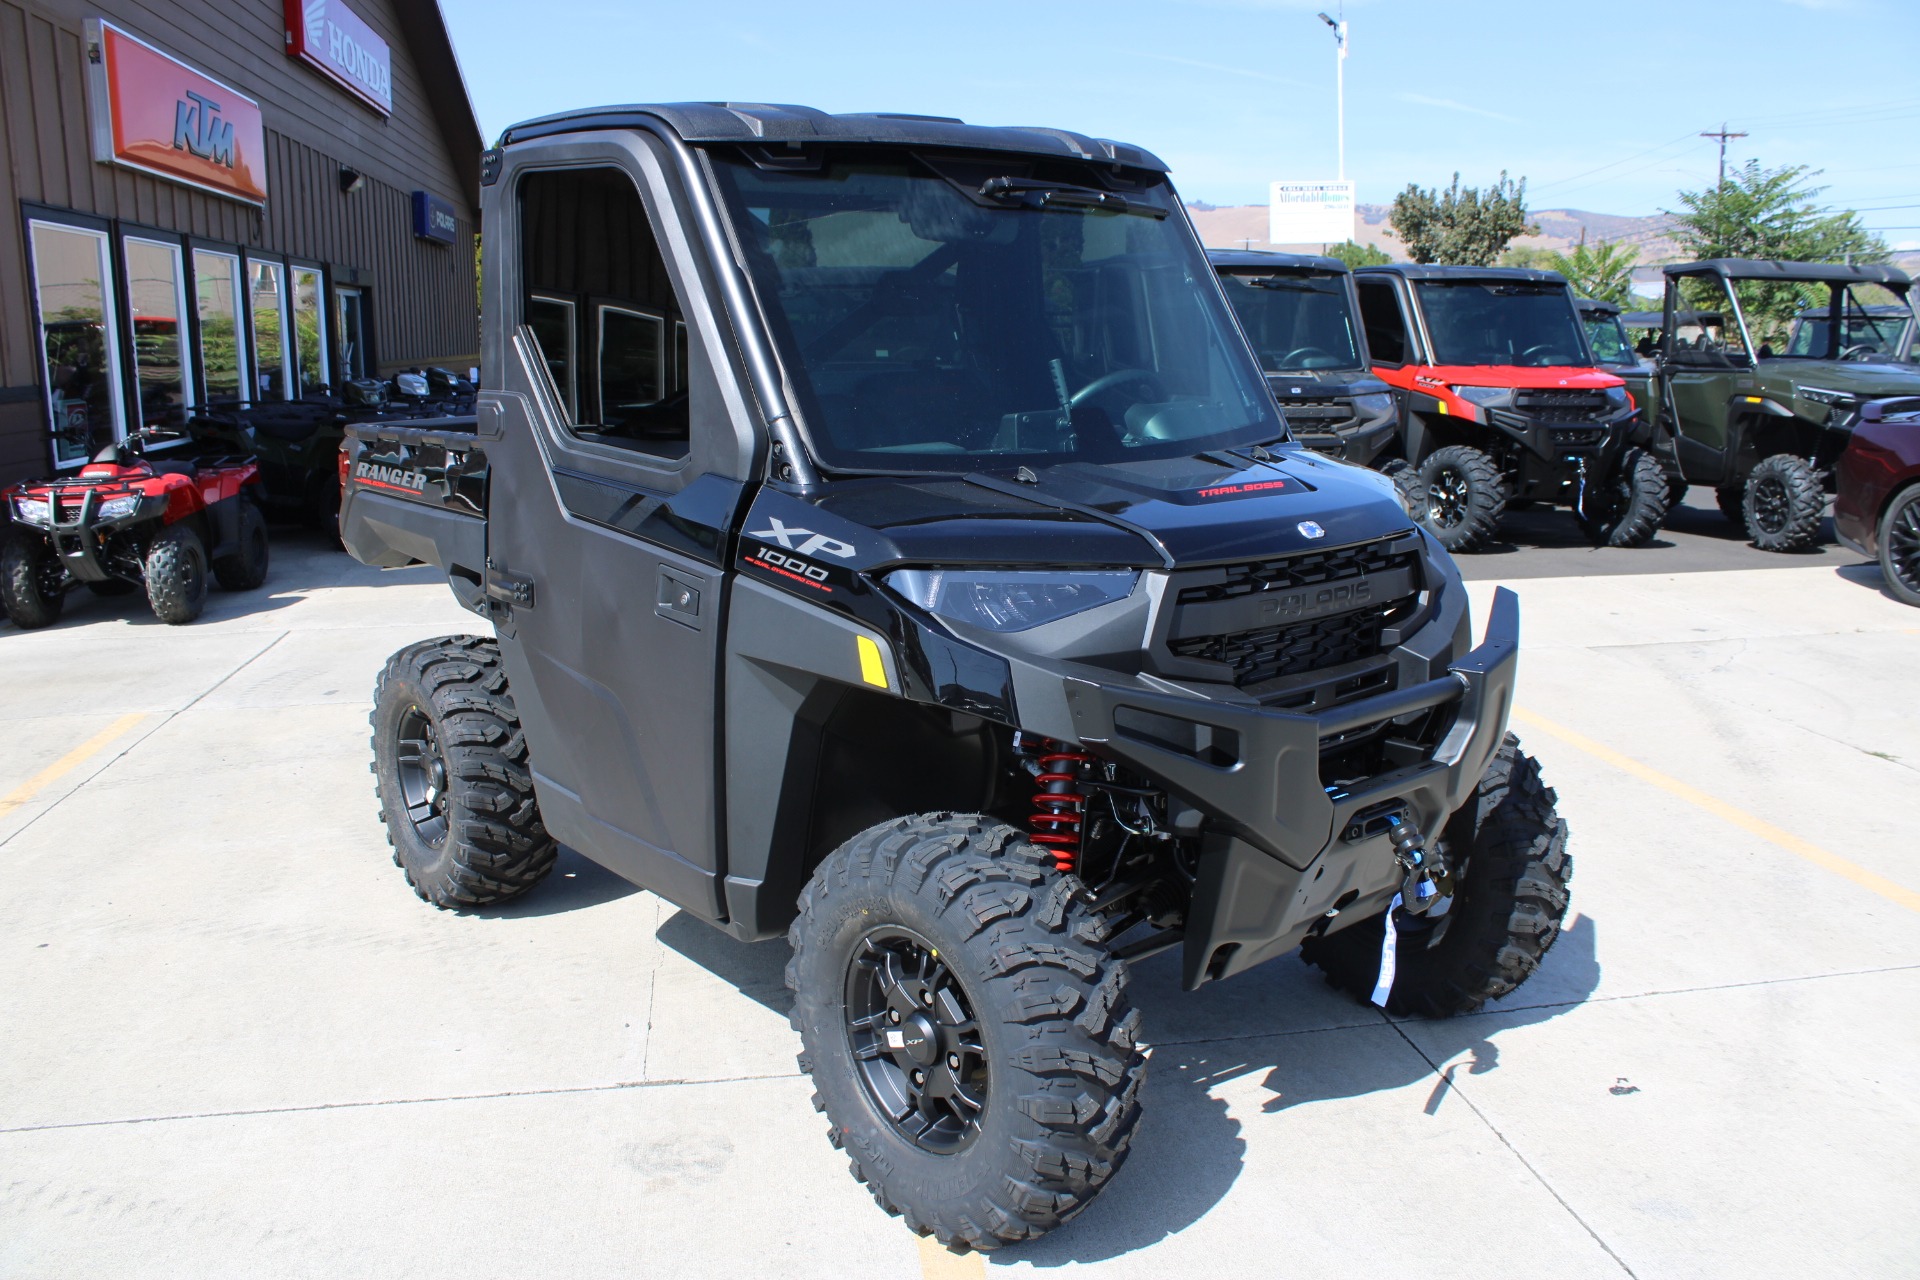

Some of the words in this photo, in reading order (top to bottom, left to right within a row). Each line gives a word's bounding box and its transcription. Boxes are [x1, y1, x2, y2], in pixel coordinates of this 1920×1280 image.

[327, 18, 391, 102] HONDA
[174, 89, 233, 169] KTM
[356, 461, 427, 490] RANGER
[1198, 486, 1242, 497] TRAIL
[1243, 481, 1284, 491] BOSS
[748, 516, 856, 558] XP
[753, 560, 771, 570] DUAL
[771, 566, 805, 582] OVERHEAD
[805, 579, 821, 589] CAM
[757, 547, 829, 581] 1000
[1259, 581, 1371, 621] POLARIS
